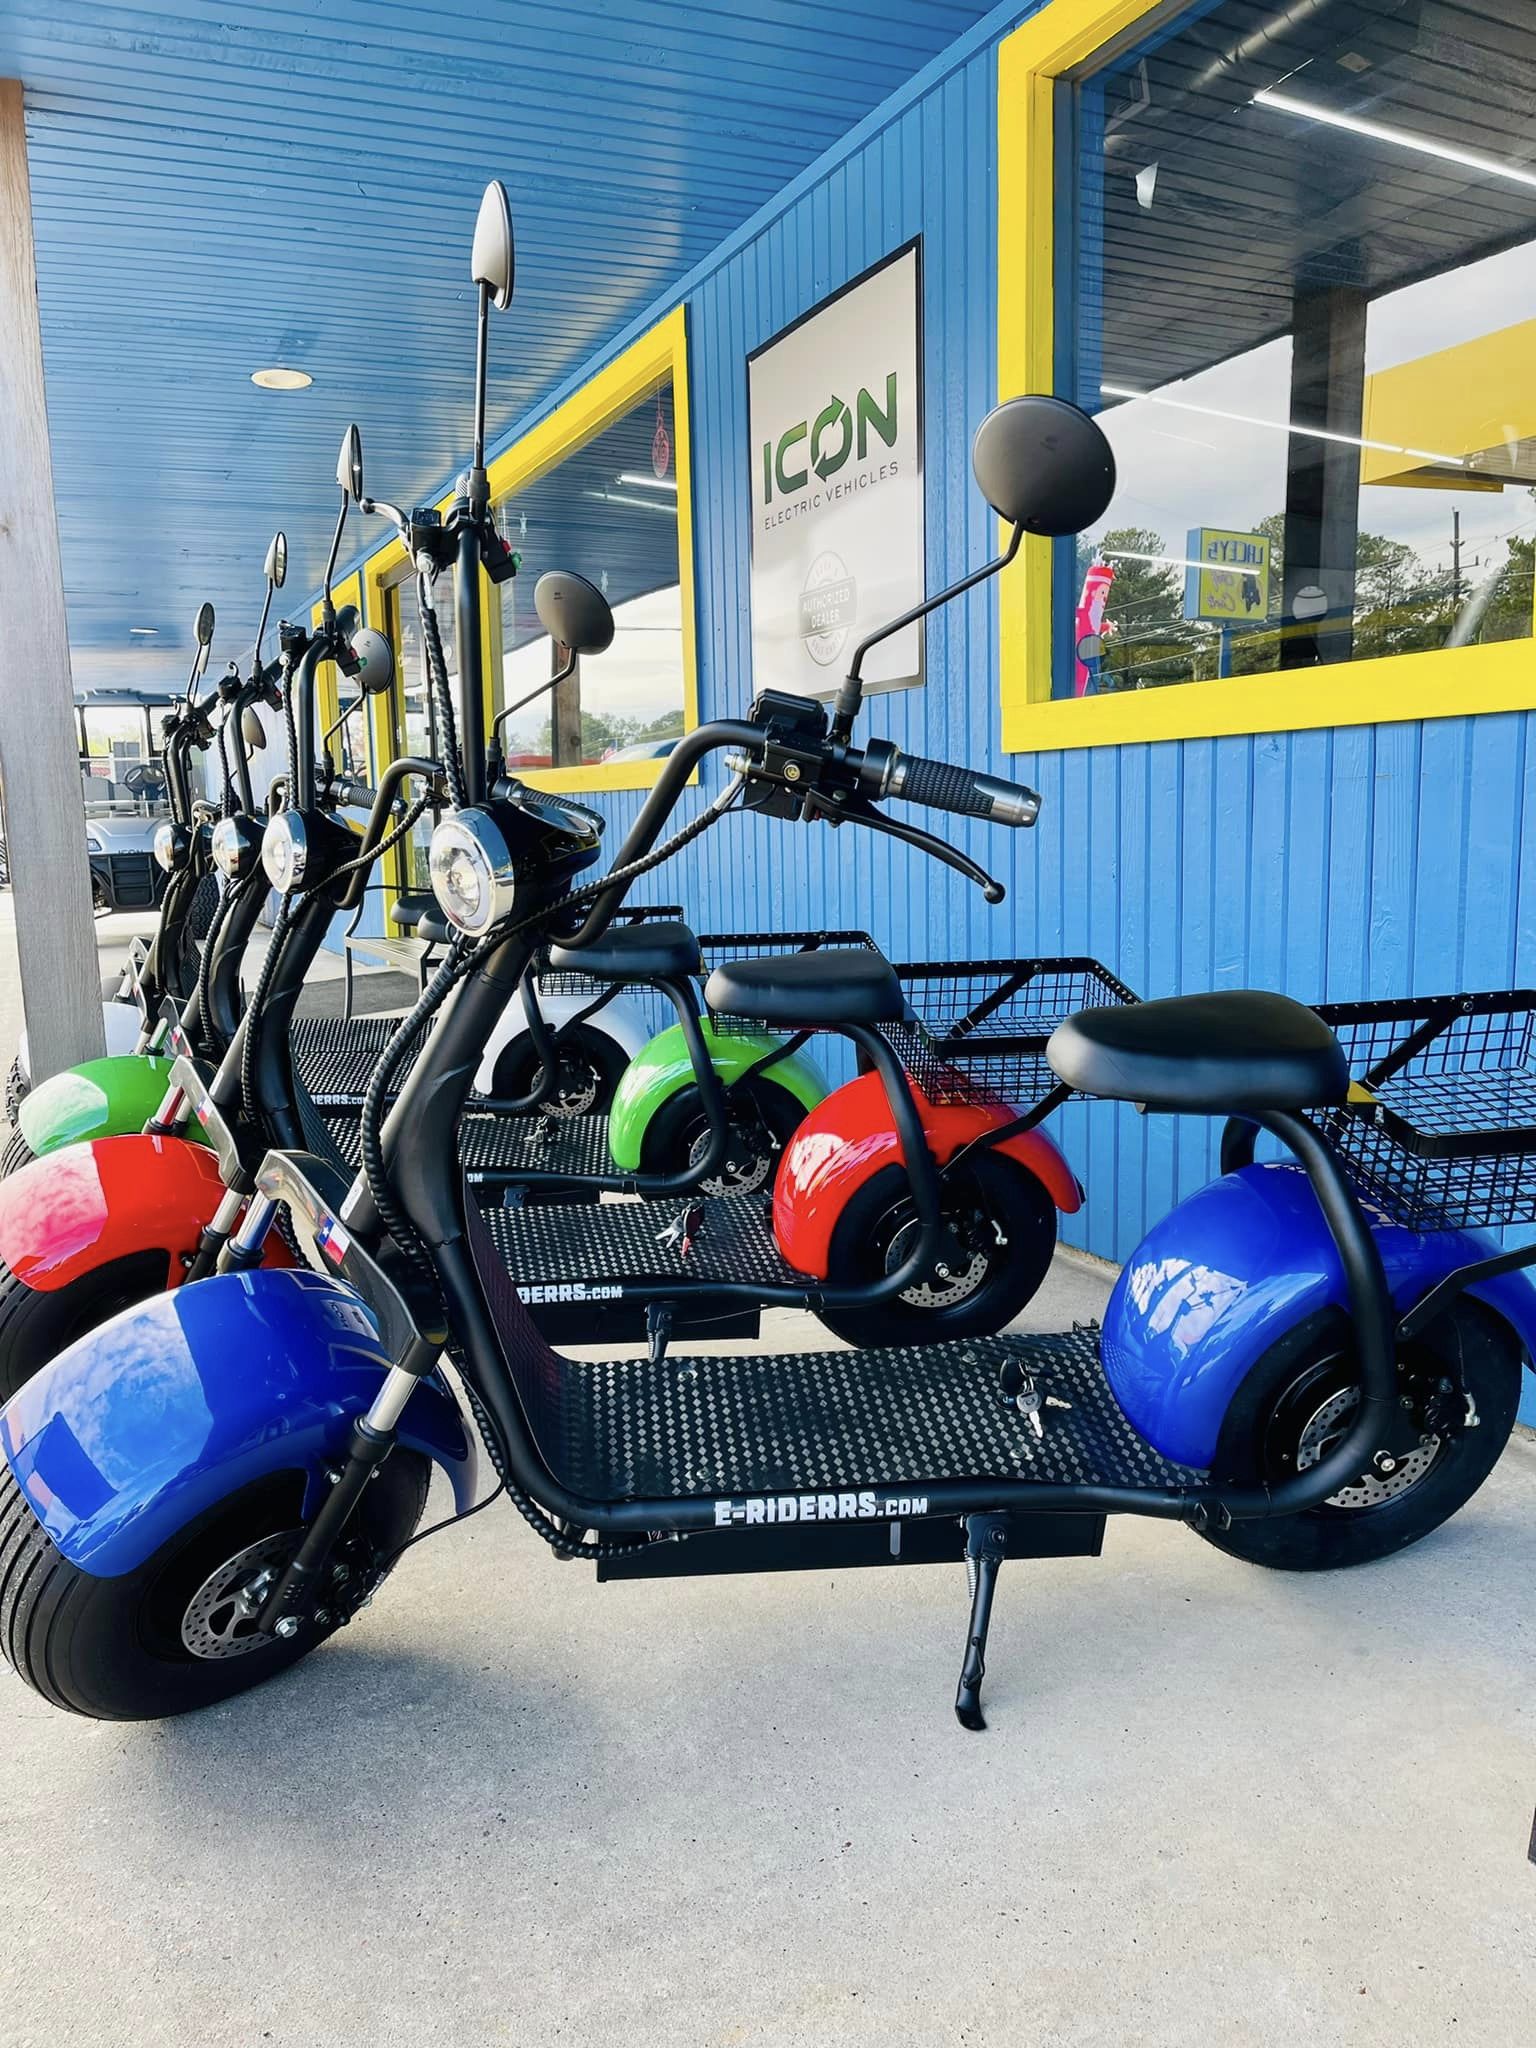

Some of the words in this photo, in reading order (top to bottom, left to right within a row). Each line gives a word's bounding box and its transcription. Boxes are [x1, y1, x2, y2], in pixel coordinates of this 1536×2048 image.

[763, 371, 898, 505] ICON
[764, 494, 821, 530] ELECTRIC
[825, 461, 899, 501] VEHICLES
[811, 608, 841, 629] DEALER
[310, 1094, 366, 1105] ERRS.CO
[516, 1283, 623, 1305] DERRS.COM
